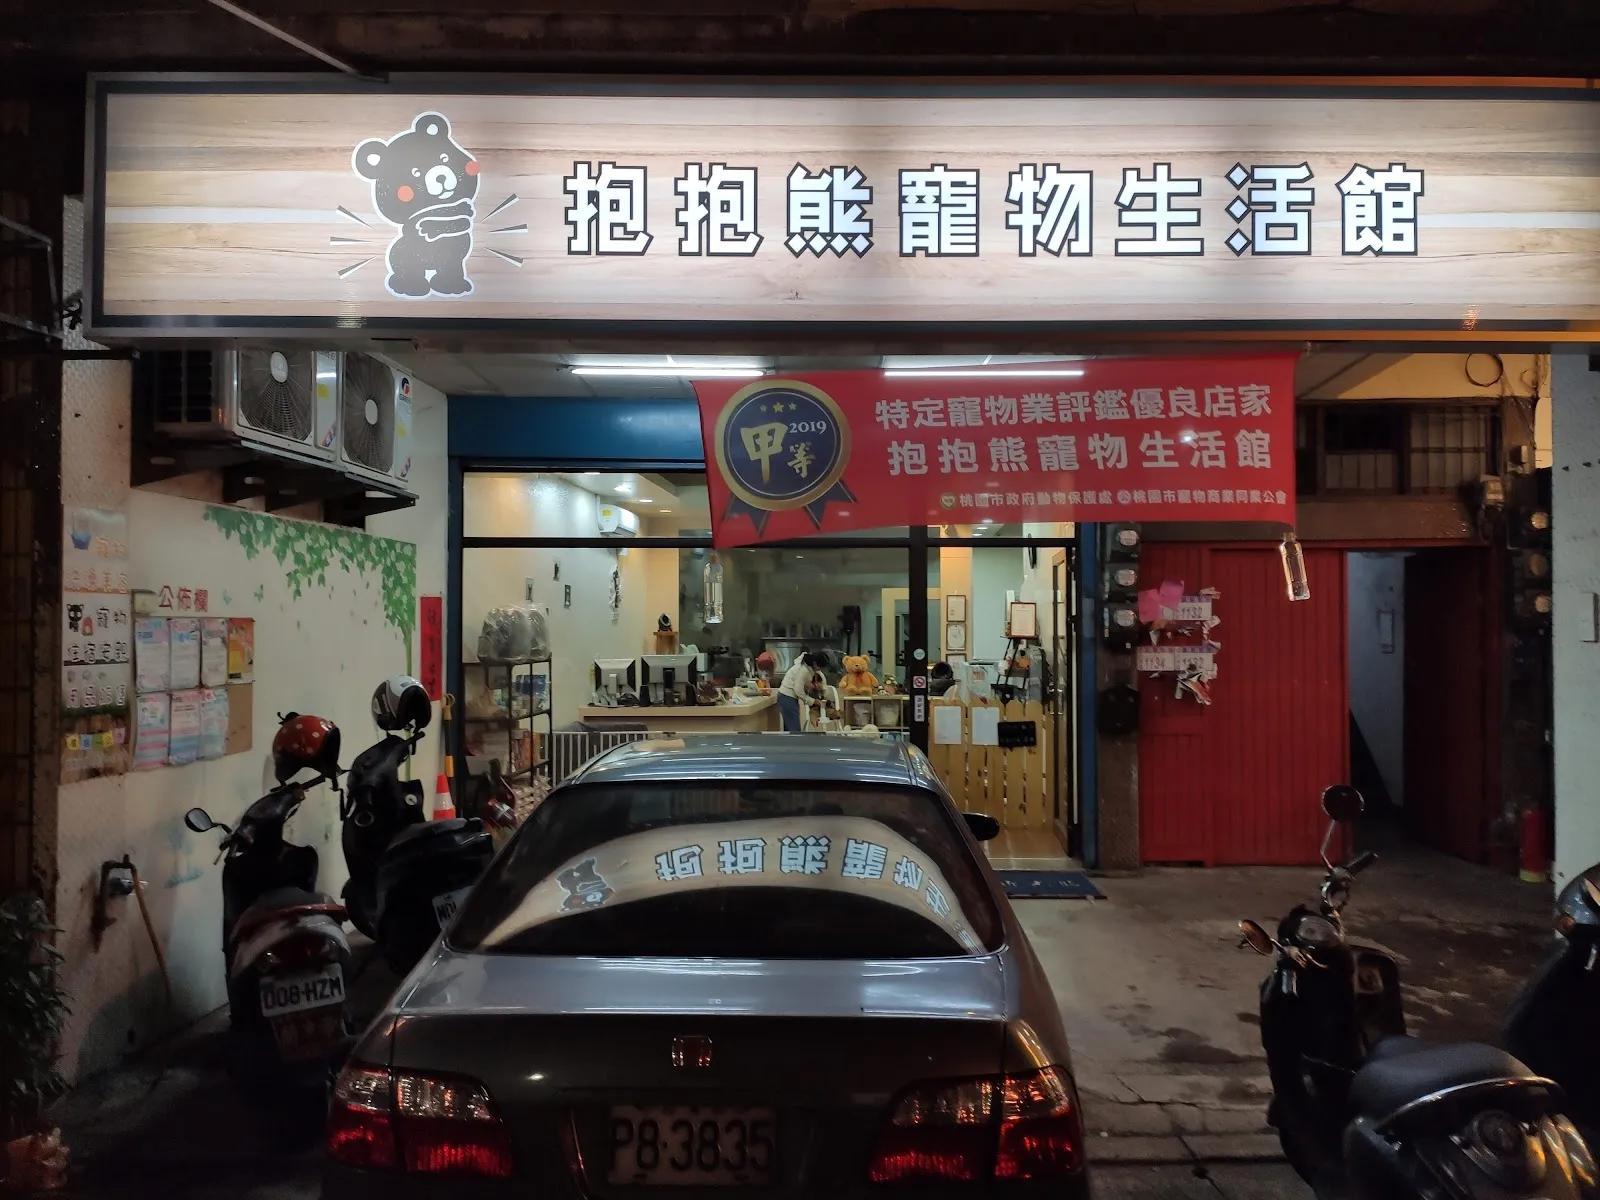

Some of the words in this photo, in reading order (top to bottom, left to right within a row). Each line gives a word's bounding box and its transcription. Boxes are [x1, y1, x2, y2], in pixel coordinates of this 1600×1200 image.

[563, 161, 1424, 257] 抱抱熊寵物生活館
[789, 420, 827, 435] 2019
[875, 384, 1272, 430] 特定寵物業評鑑優良店家
[887, 428, 1272, 476] 抱抱熊寵物生活館
